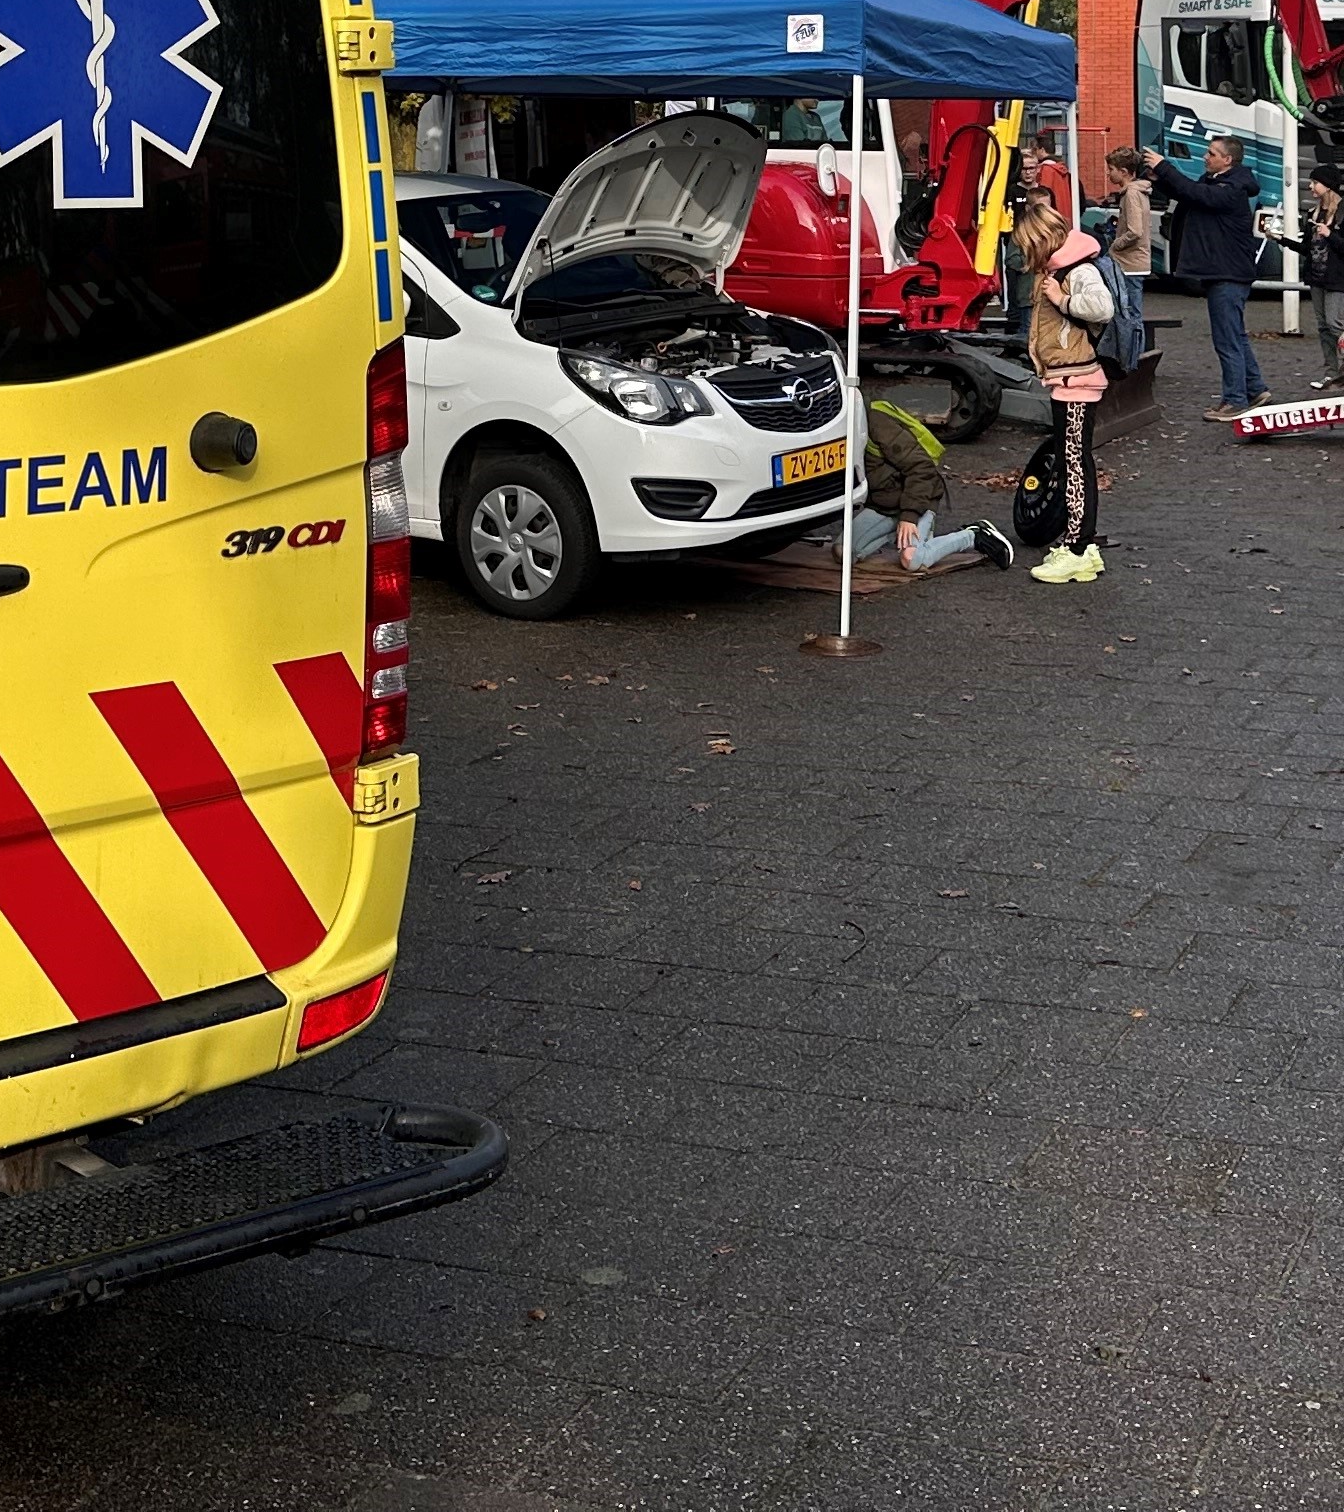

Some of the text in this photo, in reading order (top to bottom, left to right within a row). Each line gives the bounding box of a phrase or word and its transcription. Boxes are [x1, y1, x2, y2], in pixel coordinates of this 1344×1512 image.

[1178, 0, 1212, 13] SMART
[1214, 0, 1222, 10] &
[221, 519, 347, 558] 319 CDI
